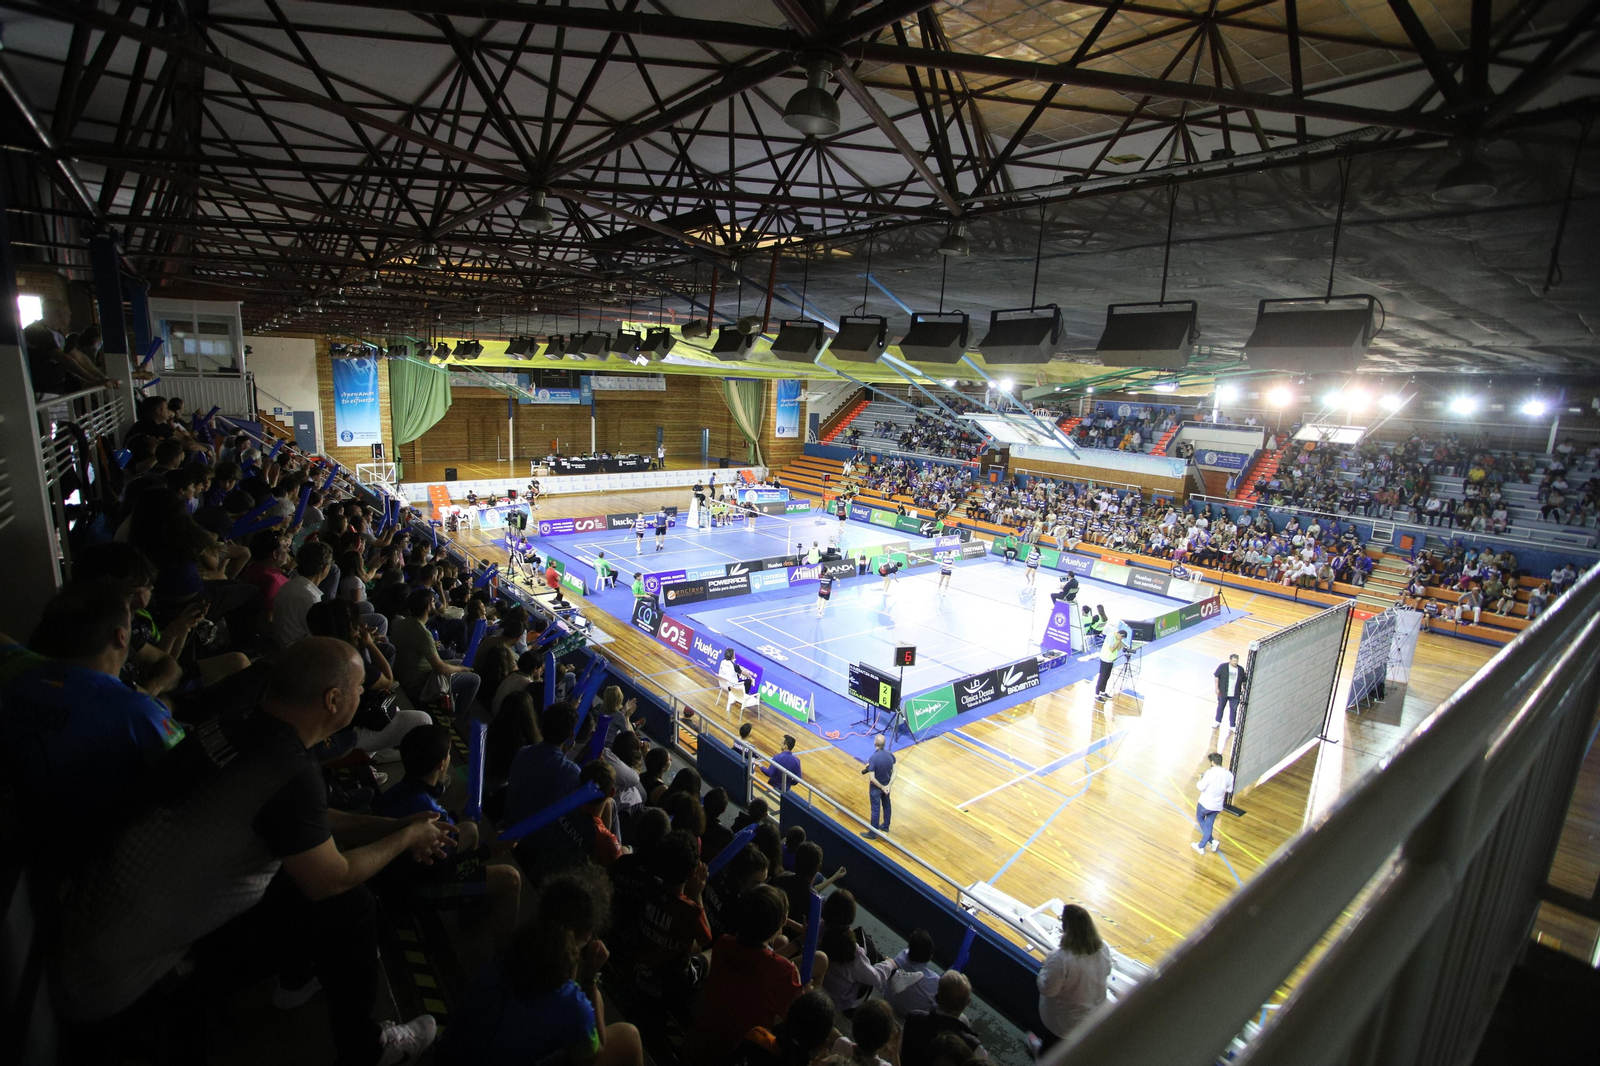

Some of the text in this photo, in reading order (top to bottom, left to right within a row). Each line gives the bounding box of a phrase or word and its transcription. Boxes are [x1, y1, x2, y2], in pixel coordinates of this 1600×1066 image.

[1062, 555, 1088, 568] Huelva
[700, 569, 724, 577] LOTERÍAS
[763, 572, 786, 580] LOTERÍAS
[1135, 574, 1152, 582] Huelva
[708, 577, 748, 587] POWERADE
[676, 586, 704, 594] enclave
[694, 637, 720, 660] Huelva
[904, 651, 912, 662] 6
[883, 686, 888, 694] 2
[1007, 678, 1040, 695] BADMINTON
[978, 686, 995, 699] Dental
[779, 688, 808, 714] YONEX
